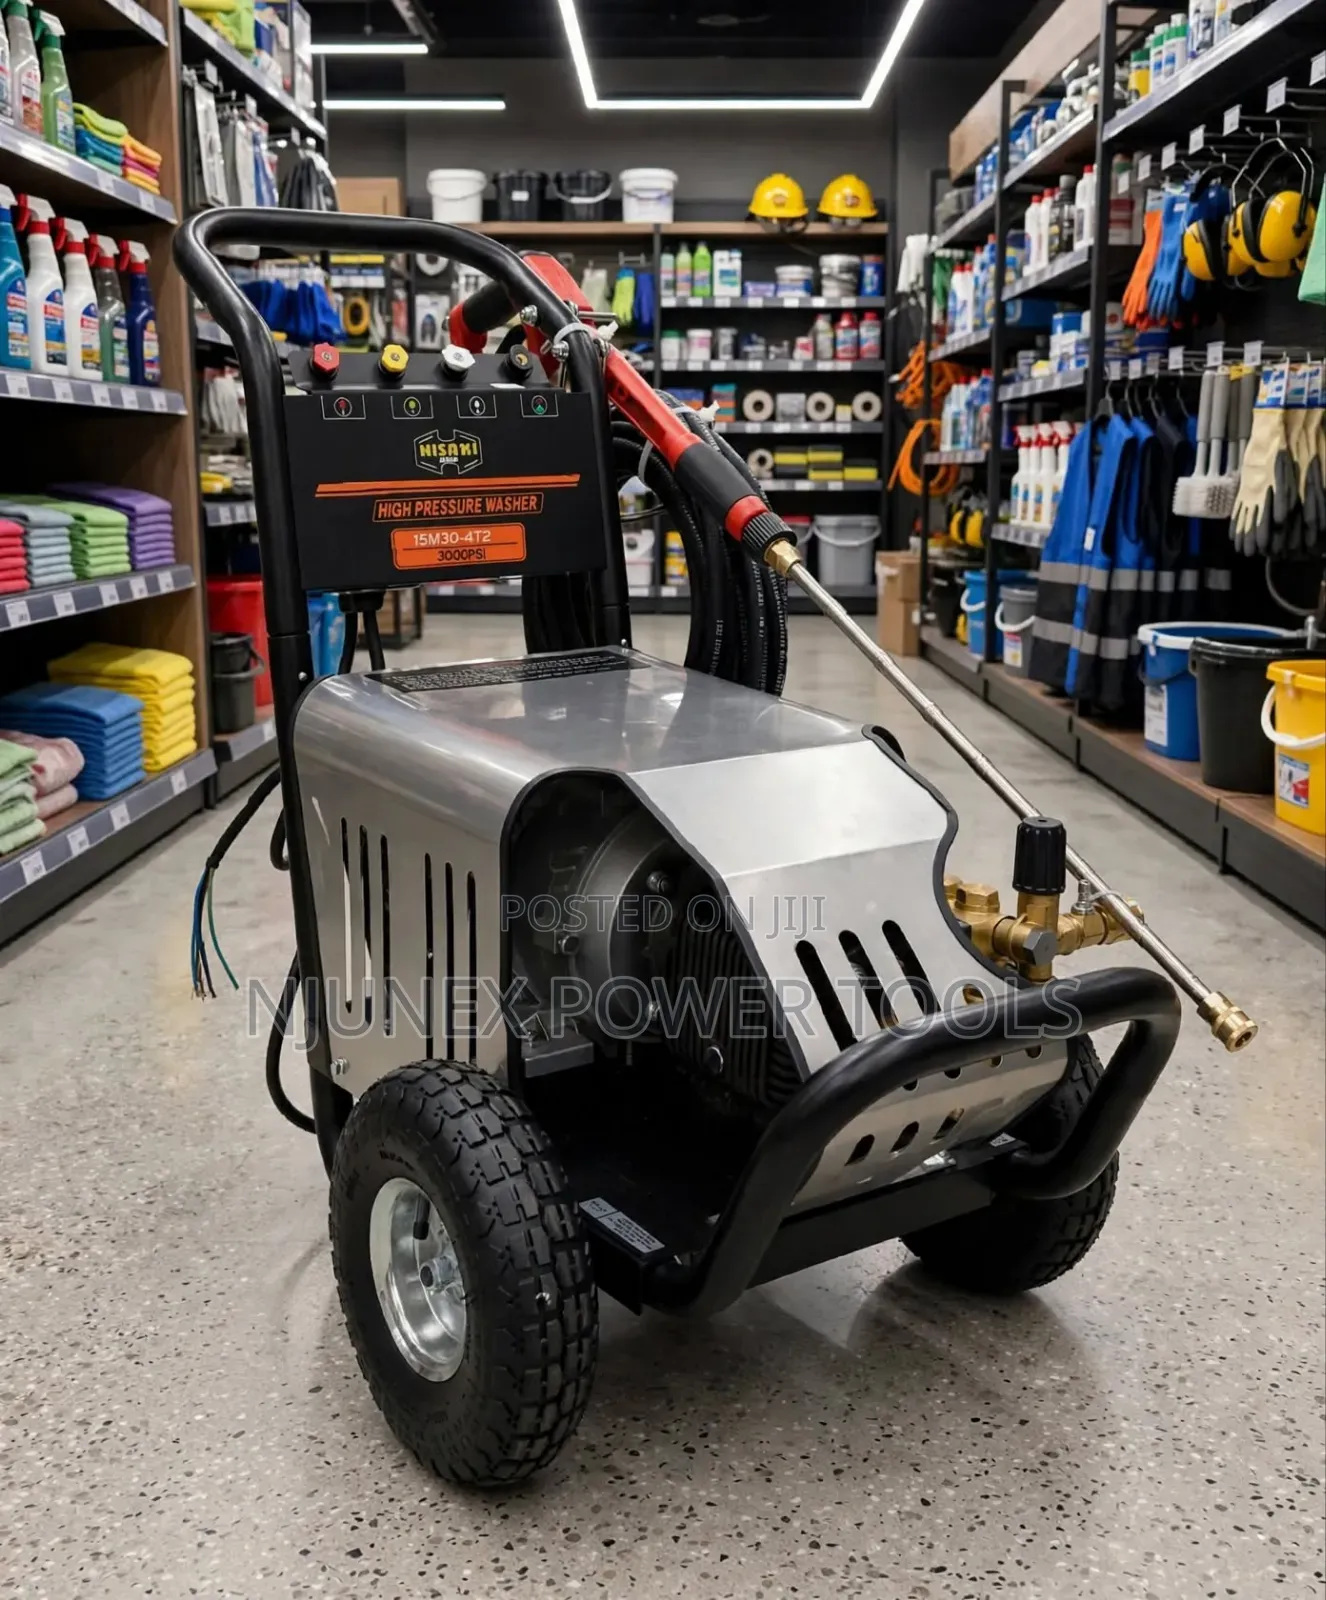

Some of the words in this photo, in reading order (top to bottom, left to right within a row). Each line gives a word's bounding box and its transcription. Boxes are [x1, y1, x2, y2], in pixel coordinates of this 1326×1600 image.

[419, 442, 478, 457] NISAKI
[378, 501, 412, 519] HIGH
[414, 497, 483, 517] PRESSURE
[485, 495, 538, 513] WASHER
[413, 530, 492, 547] 15M30-4T2
[437, 547, 487, 562] 3000PSI
